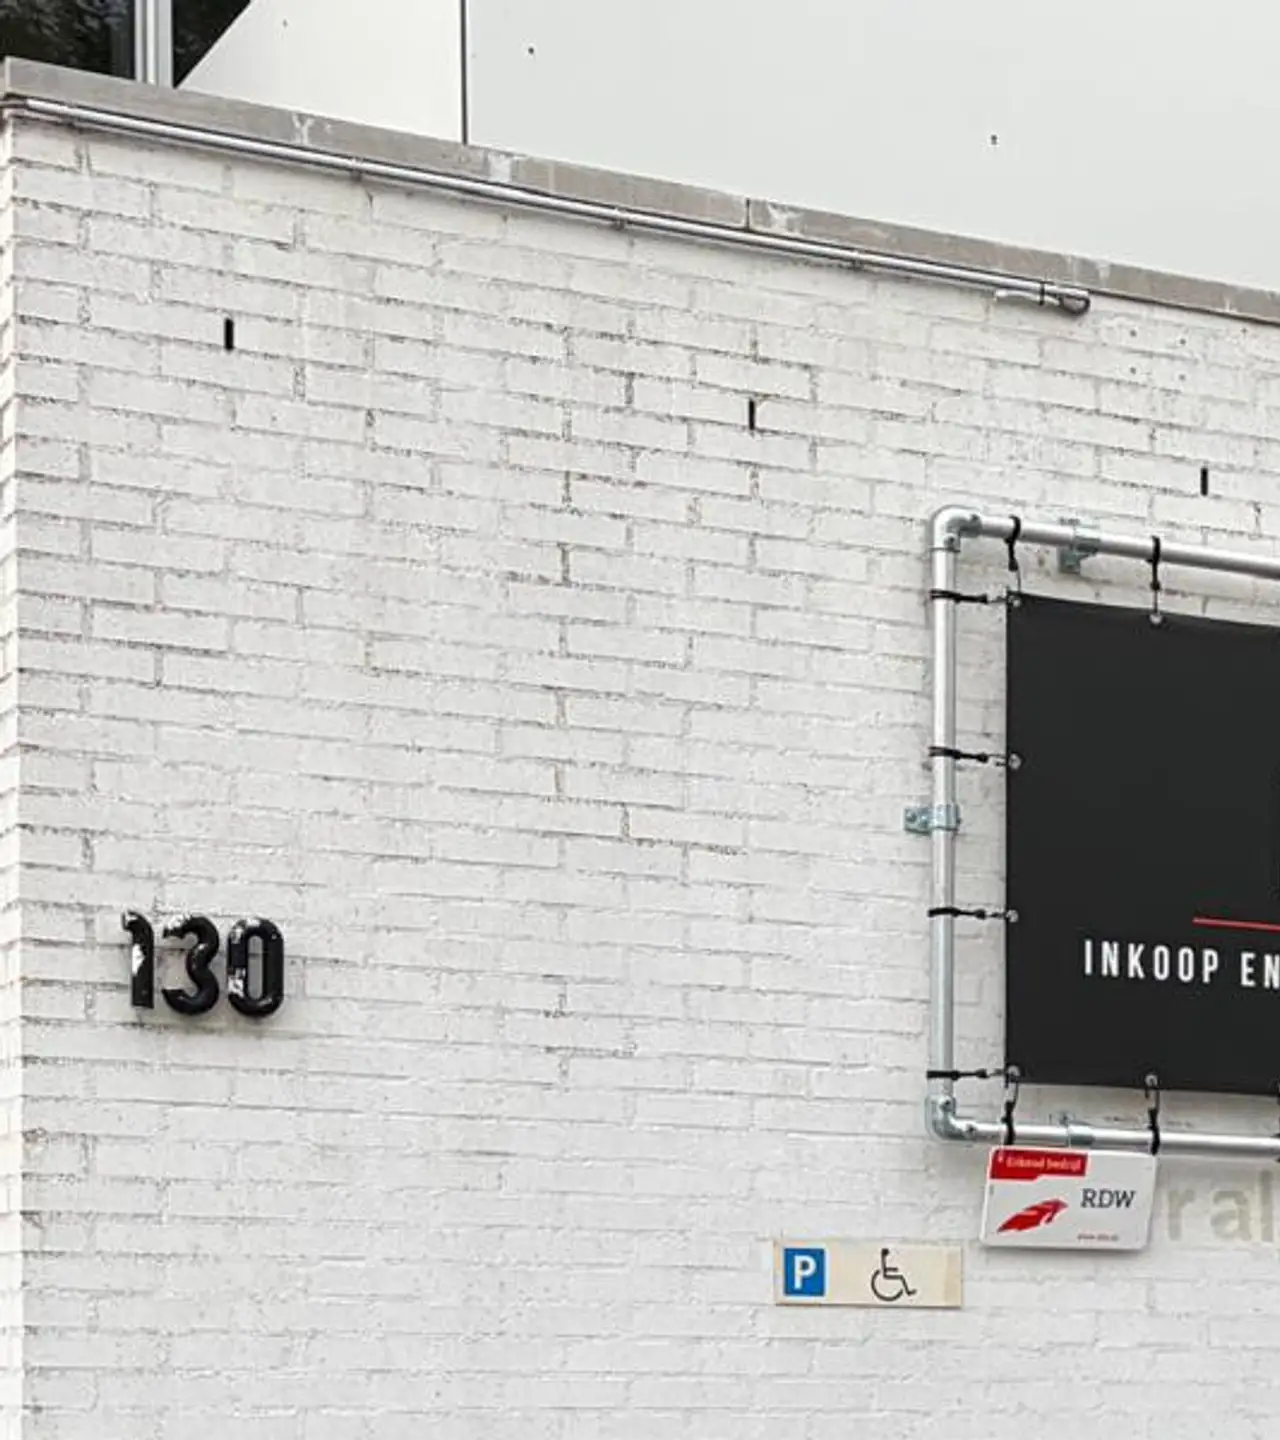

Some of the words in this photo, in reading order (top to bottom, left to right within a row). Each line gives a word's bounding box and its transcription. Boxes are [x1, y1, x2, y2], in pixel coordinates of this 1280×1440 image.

[121, 910, 285, 1019] 130
[1083, 939, 1219, 983] INKOOP
[1240, 952, 1280, 990] EN
[1080, 1188, 1138, 1208] RDW
[793, 1255, 817, 1289] P
